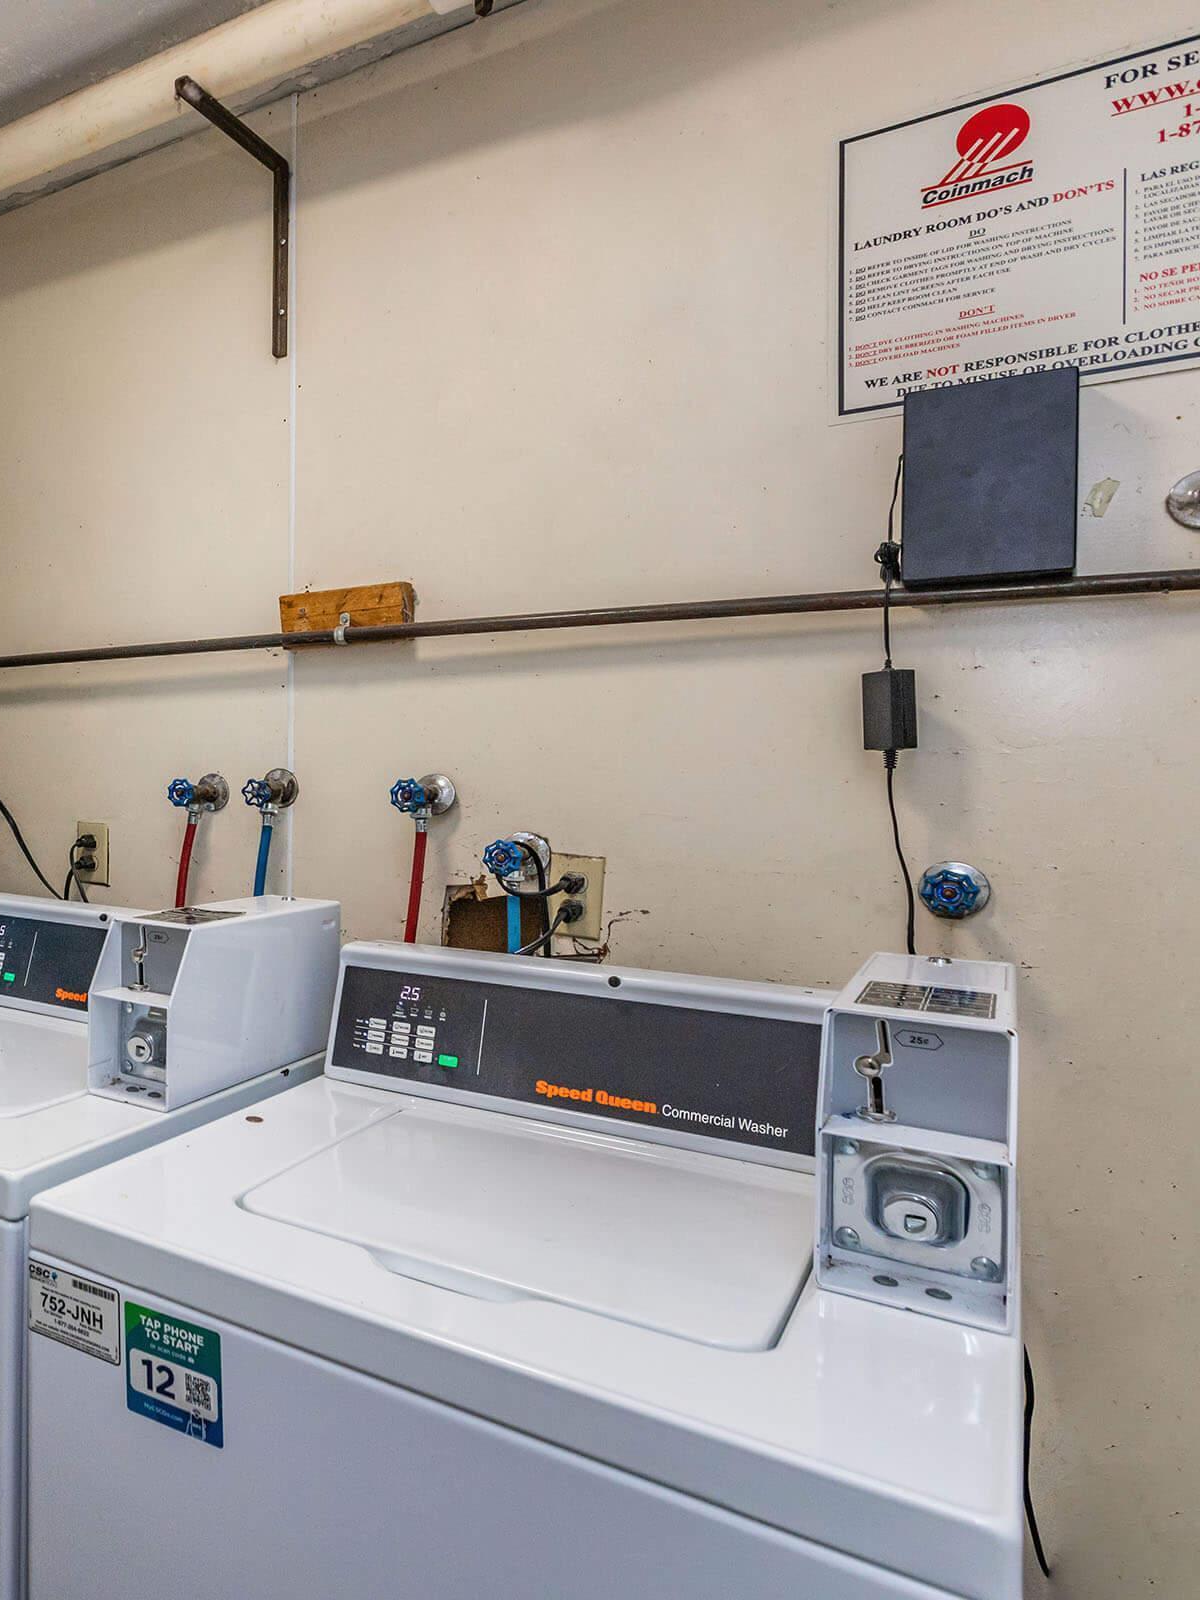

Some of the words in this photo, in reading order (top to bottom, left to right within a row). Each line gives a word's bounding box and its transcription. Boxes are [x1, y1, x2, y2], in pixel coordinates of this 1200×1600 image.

[1104, 61, 1159, 89] FOR
[922, 164, 1033, 206] Coinmach
[854, 227, 921, 251] LAUNDRY
[926, 214, 971, 233] ROOM
[976, 204, 1011, 222] DO'S
[1015, 195, 1048, 212] AND
[1052, 179, 1114, 203] DON'TS
[968, 227, 985, 238] DO
[1139, 270, 1158, 282] NO
[1161, 266, 1177, 277] SE
[958, 304, 995, 319] DON'T
[864, 376, 887, 389] WE
[891, 370, 922, 384] ARE
[926, 364, 959, 378] NOT
[964, 343, 1077, 372] RESPONSIBLE
[1083, 335, 1119, 351] FOR
[1023, 362, 1045, 374] OR
[1052, 338, 1187, 371] OVERLOADING
[55, 988, 87, 1003] Speed
[400, 985, 421, 1001] 2.5
[535, 1080, 592, 1103] Speed
[595, 1090, 657, 1114] Queen
[662, 1104, 735, 1129] Commercial
[738, 1117, 788, 1138] Washer
[29, 1264, 50, 1278] CSC
[40, 1292, 103, 1330] 752-JNH
[139, 1314, 161, 1329] TAP
[164, 1322, 204, 1346] PHONE
[145, 1328, 160, 1340] TO
[163, 1334, 200, 1355] START
[141, 1359, 175, 1400] 12
